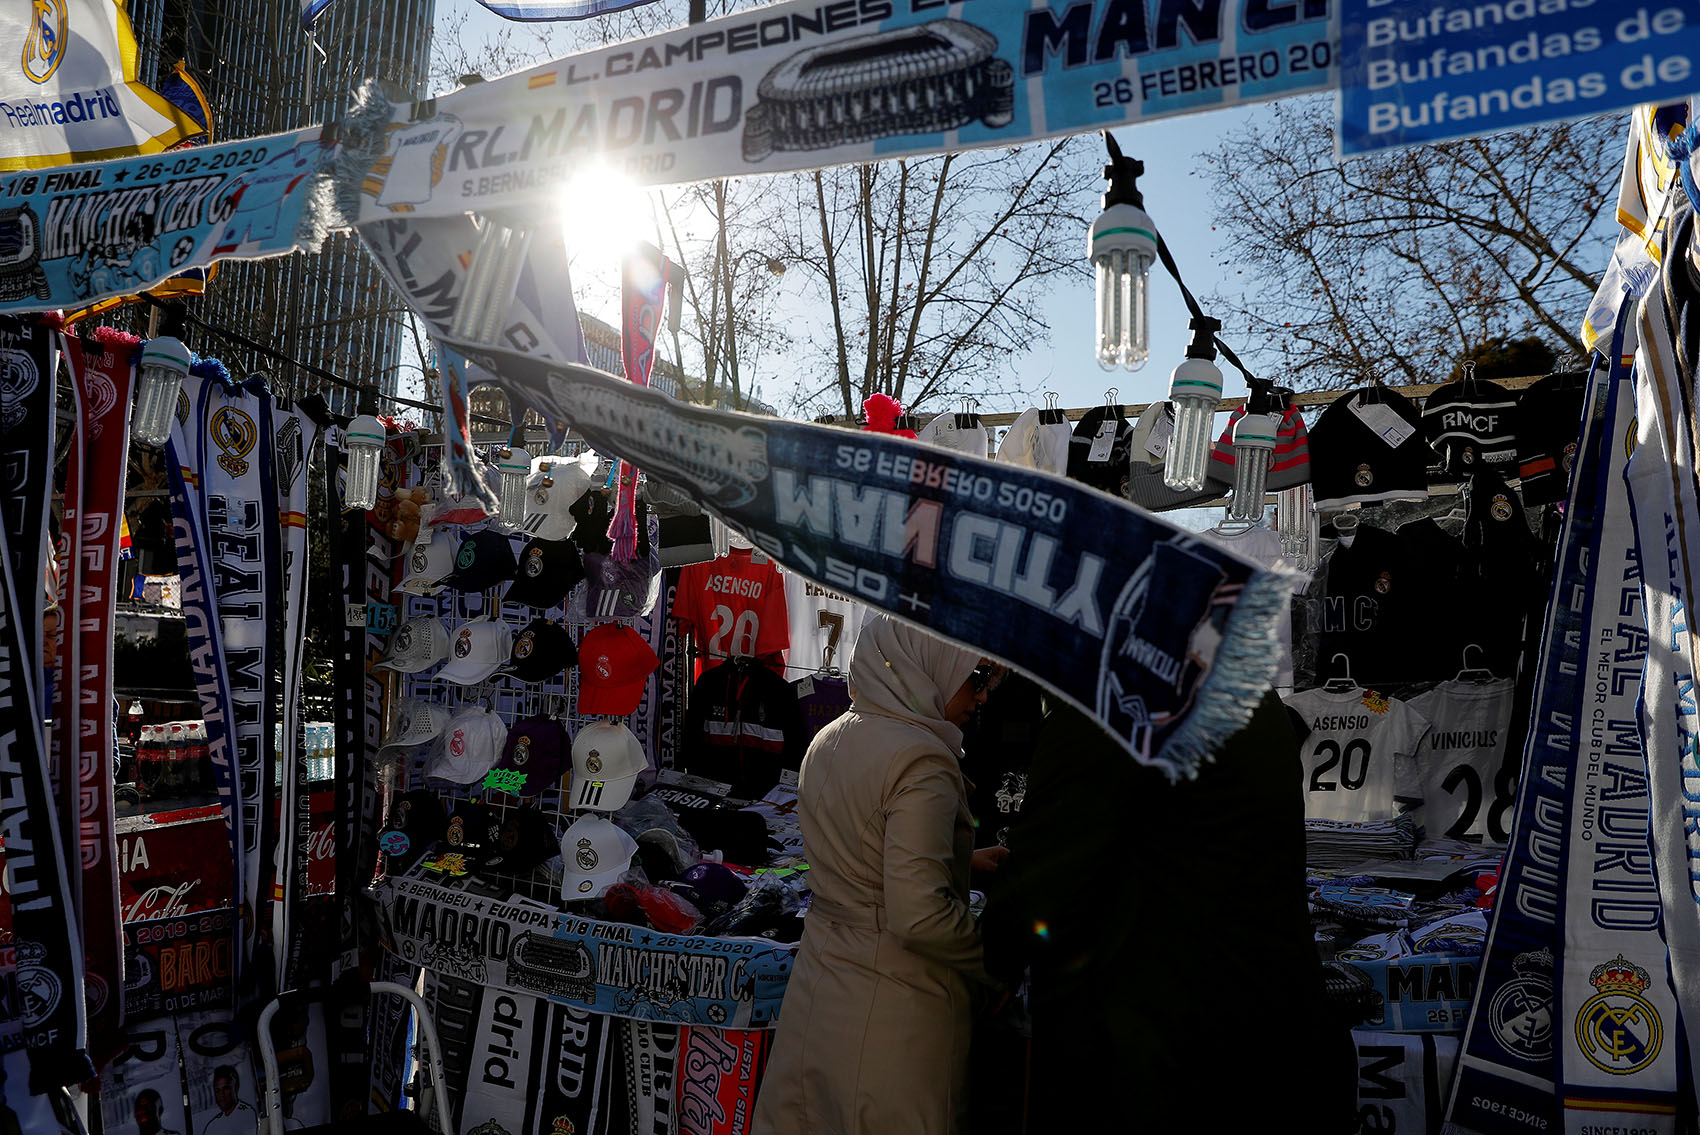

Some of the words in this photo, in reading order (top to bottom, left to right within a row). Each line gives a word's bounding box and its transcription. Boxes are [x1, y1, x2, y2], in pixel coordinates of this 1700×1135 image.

[1367, 0, 1596, 48] Bufanda
[1367, 27, 1601, 91] Bufandas
[1615, 8, 1685, 44] de
[1094, 79, 1133, 107] 26
[1141, 50, 1280, 100] FEBRERO
[1368, 73, 1607, 135] Bufandas
[1620, 54, 1692, 91] de
[7, 174, 42, 198] 1/8
[41, 168, 104, 196] FINAL
[134, 147, 268, 180] 26-02-2020
[42, 172, 226, 261] MANCHESTER
[1442, 411, 1499, 433] RMCF
[705, 574, 762, 599] ASENSIO
[708, 604, 760, 662] 20
[817, 609, 845, 668] 7
[1601, 628, 1613, 645] EL
[1597, 652, 1611, 703] MEJOR
[1312, 715, 1369, 731] ASENSIO
[1431, 730, 1498, 750] VINICIUS
[1592, 709, 1605, 747] CLUB
[1309, 738, 1372, 792] 20
[1588, 751, 1600, 775] DEL
[1440, 764, 1516, 845] 28
[1581, 783, 1597, 841] MUNDO
[119, 836, 150, 874] IA
[393, 895, 511, 962] MADRID
[408, 883, 471, 908] BERNABÉU
[488, 903, 550, 929] EUROPA
[565, 919, 590, 935] 1/8
[591, 925, 633, 943] FINAL
[657, 936, 754, 954] 26-02-2020
[160, 940, 234, 993] BARC
[596, 941, 729, 1001] MANCHESTER
[199, 987, 227, 1006] MAR
[739, 1040, 754, 1081] LISTA
